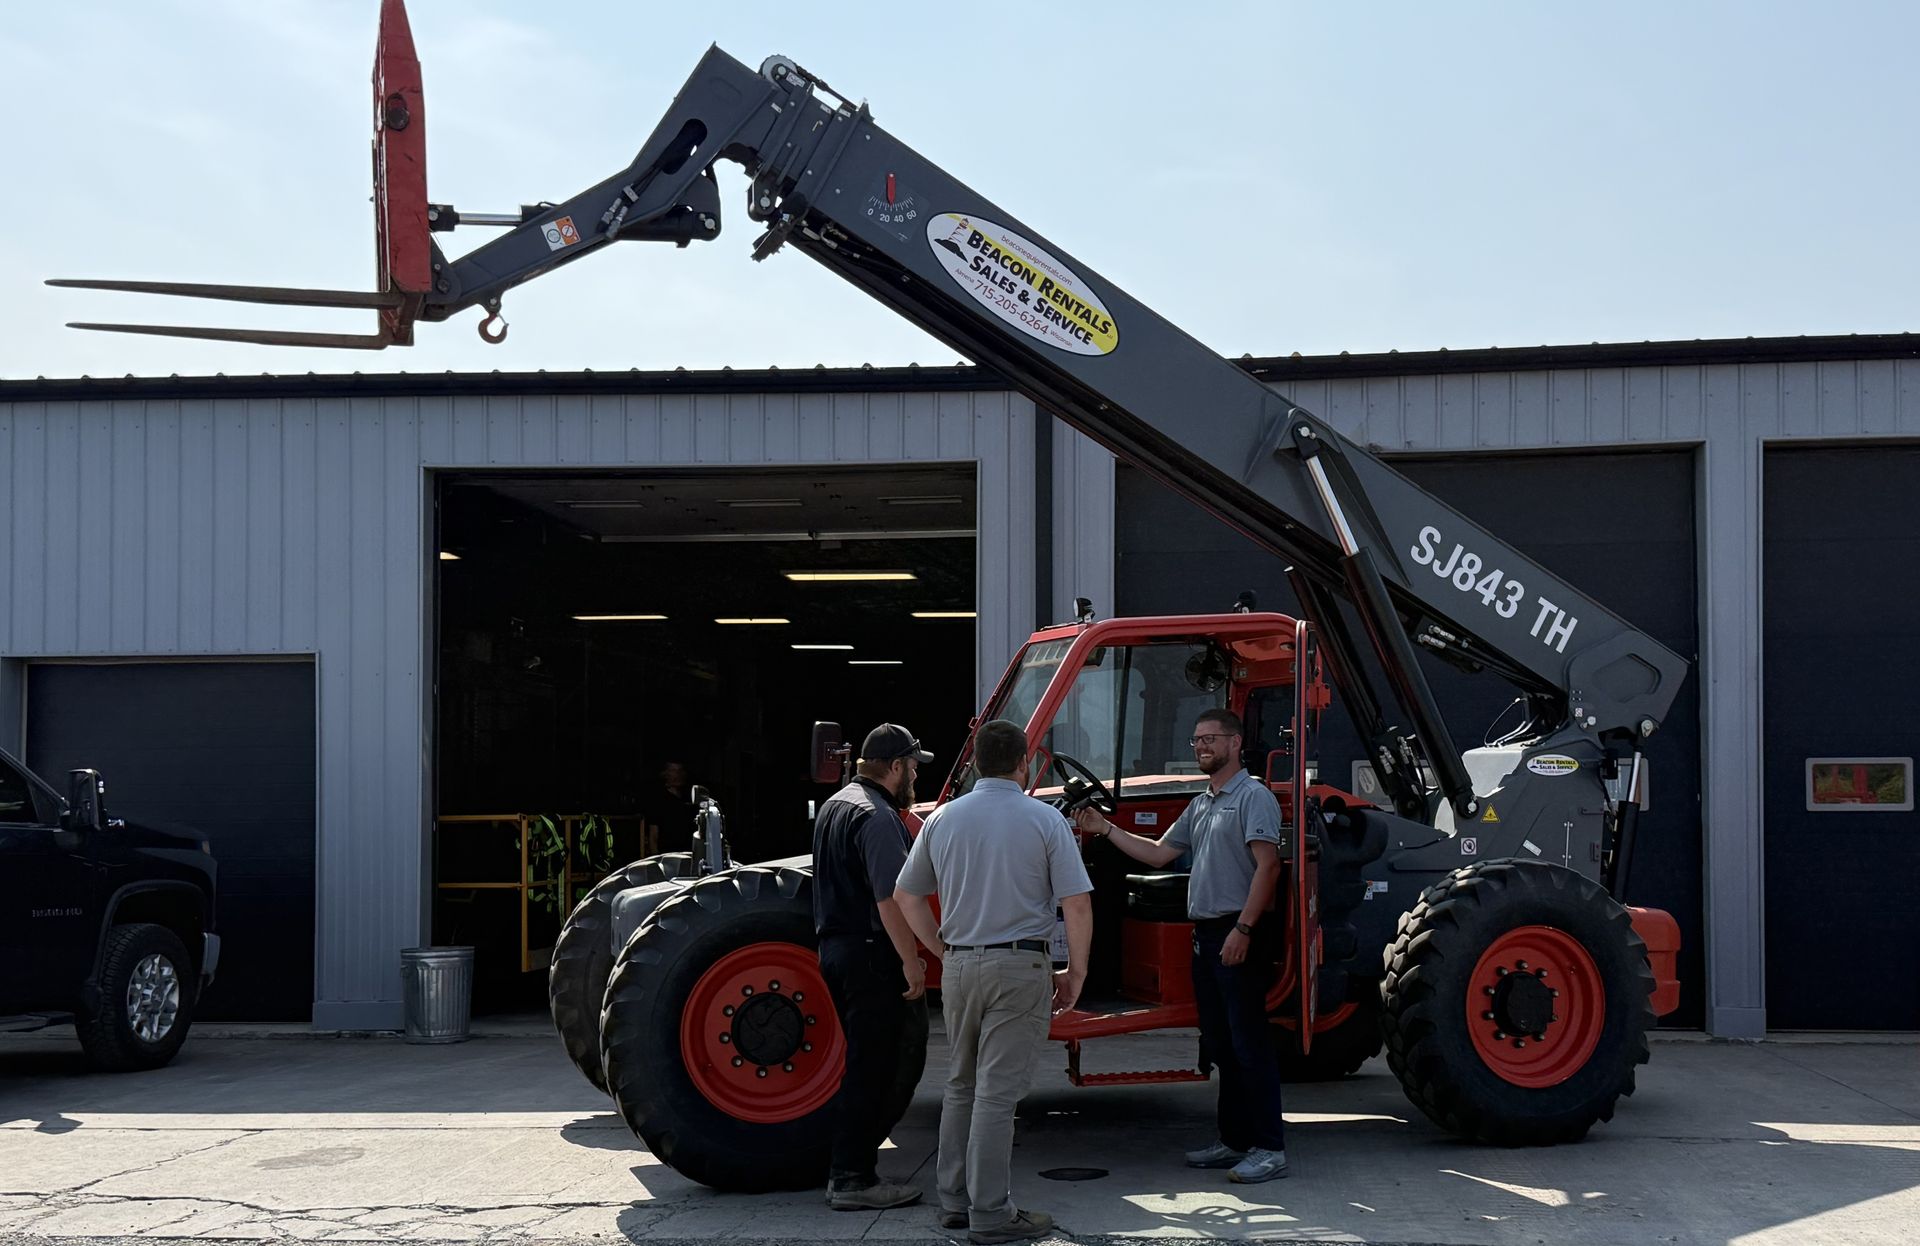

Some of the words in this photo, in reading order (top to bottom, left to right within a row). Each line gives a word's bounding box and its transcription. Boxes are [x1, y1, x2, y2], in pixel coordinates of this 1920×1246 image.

[867, 208, 874, 216] 0
[880, 213, 890, 223] 20
[893, 214, 904, 223] 40
[906, 209, 917, 220] 60
[966, 229, 1037, 286] BEACON
[1038, 277, 1112, 335] RENTALS
[1001, 234, 1073, 286] beaconequiprentals.com
[969, 255, 1018, 295] SALES
[1018, 289, 1030, 306] &
[1033, 297, 1093, 345] SERVICE
[973, 279, 1049, 335] 715-205-6264
[1050, 328, 1073, 348] Wisconsin
[1410, 525, 1525, 618] SJ843
[1529, 596, 1578, 654] TH
